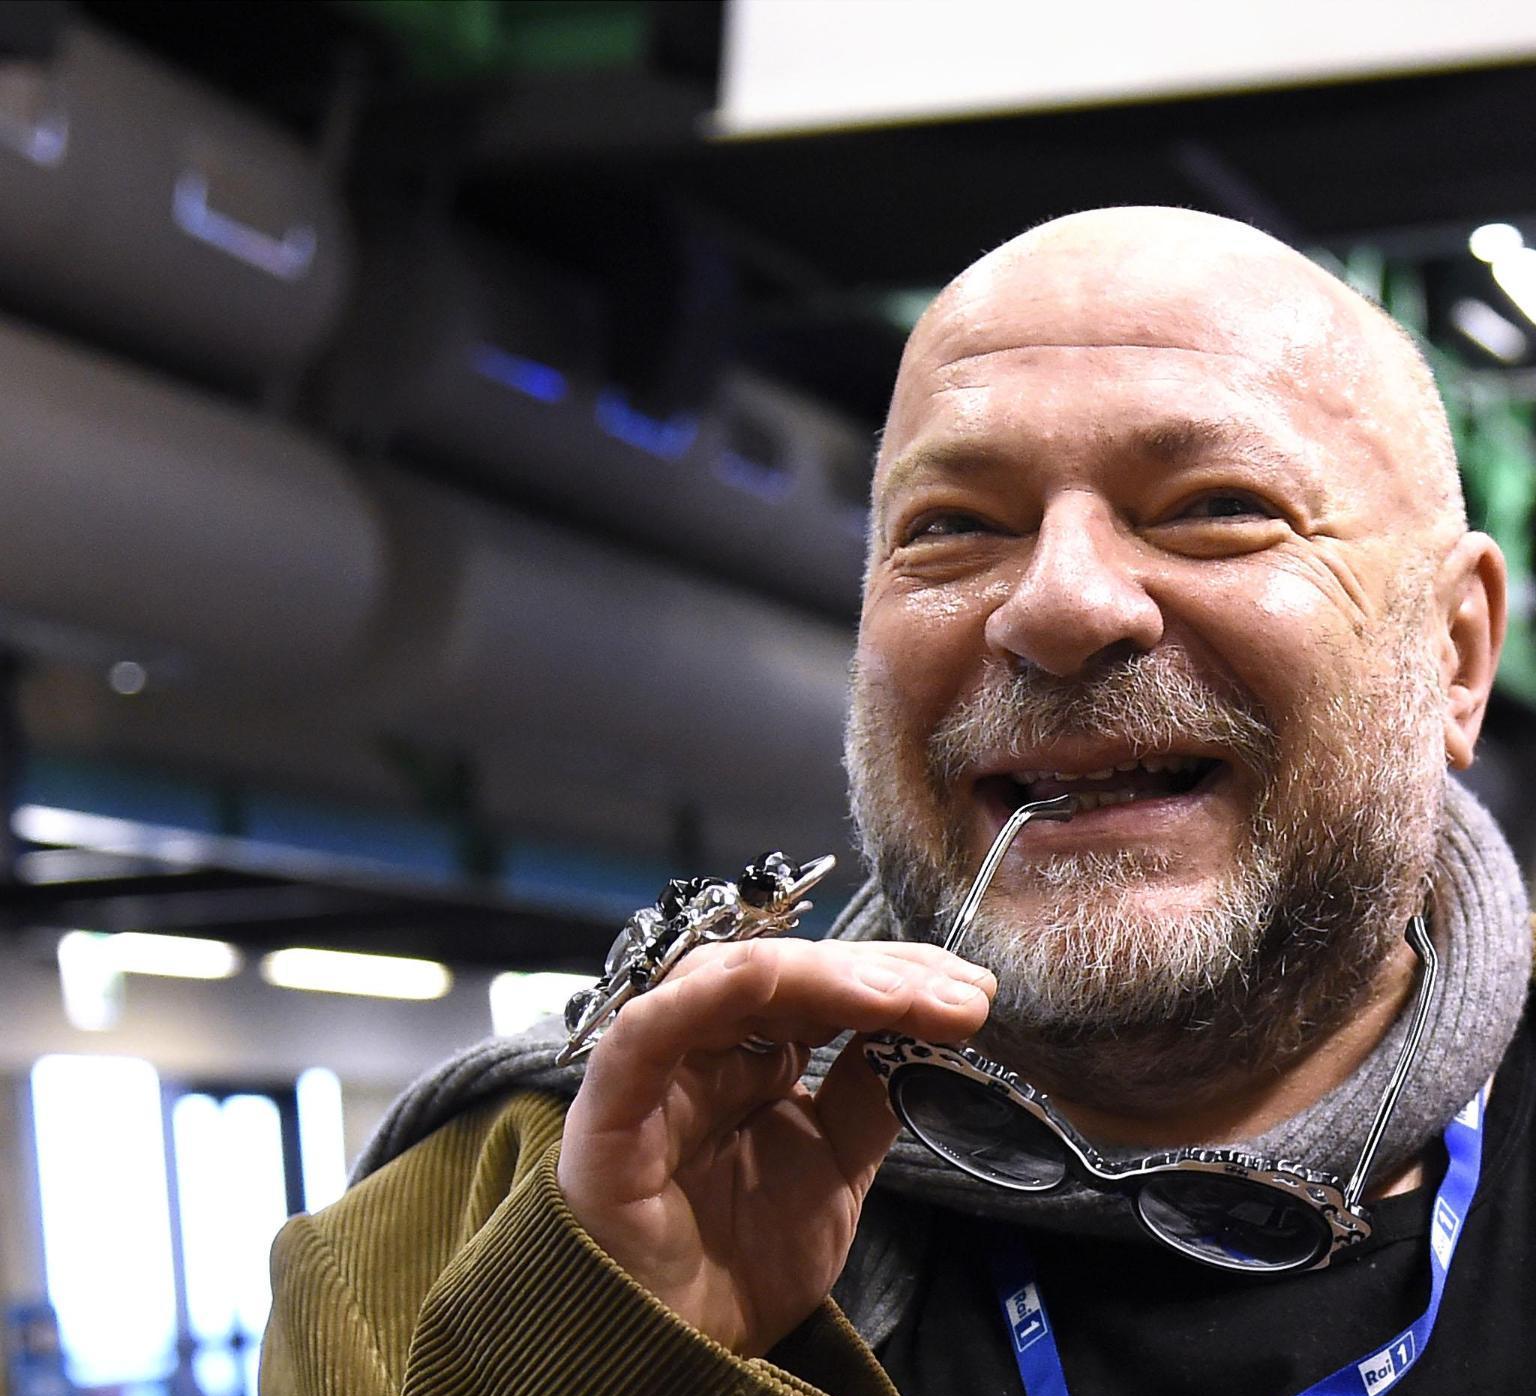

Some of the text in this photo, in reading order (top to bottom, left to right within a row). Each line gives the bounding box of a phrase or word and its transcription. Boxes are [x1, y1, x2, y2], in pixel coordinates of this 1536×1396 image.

[1439, 1209, 1454, 1231] 1
[1013, 1289, 1041, 1338] Rai 1
[1364, 1343, 1408, 1387] Rai 1
